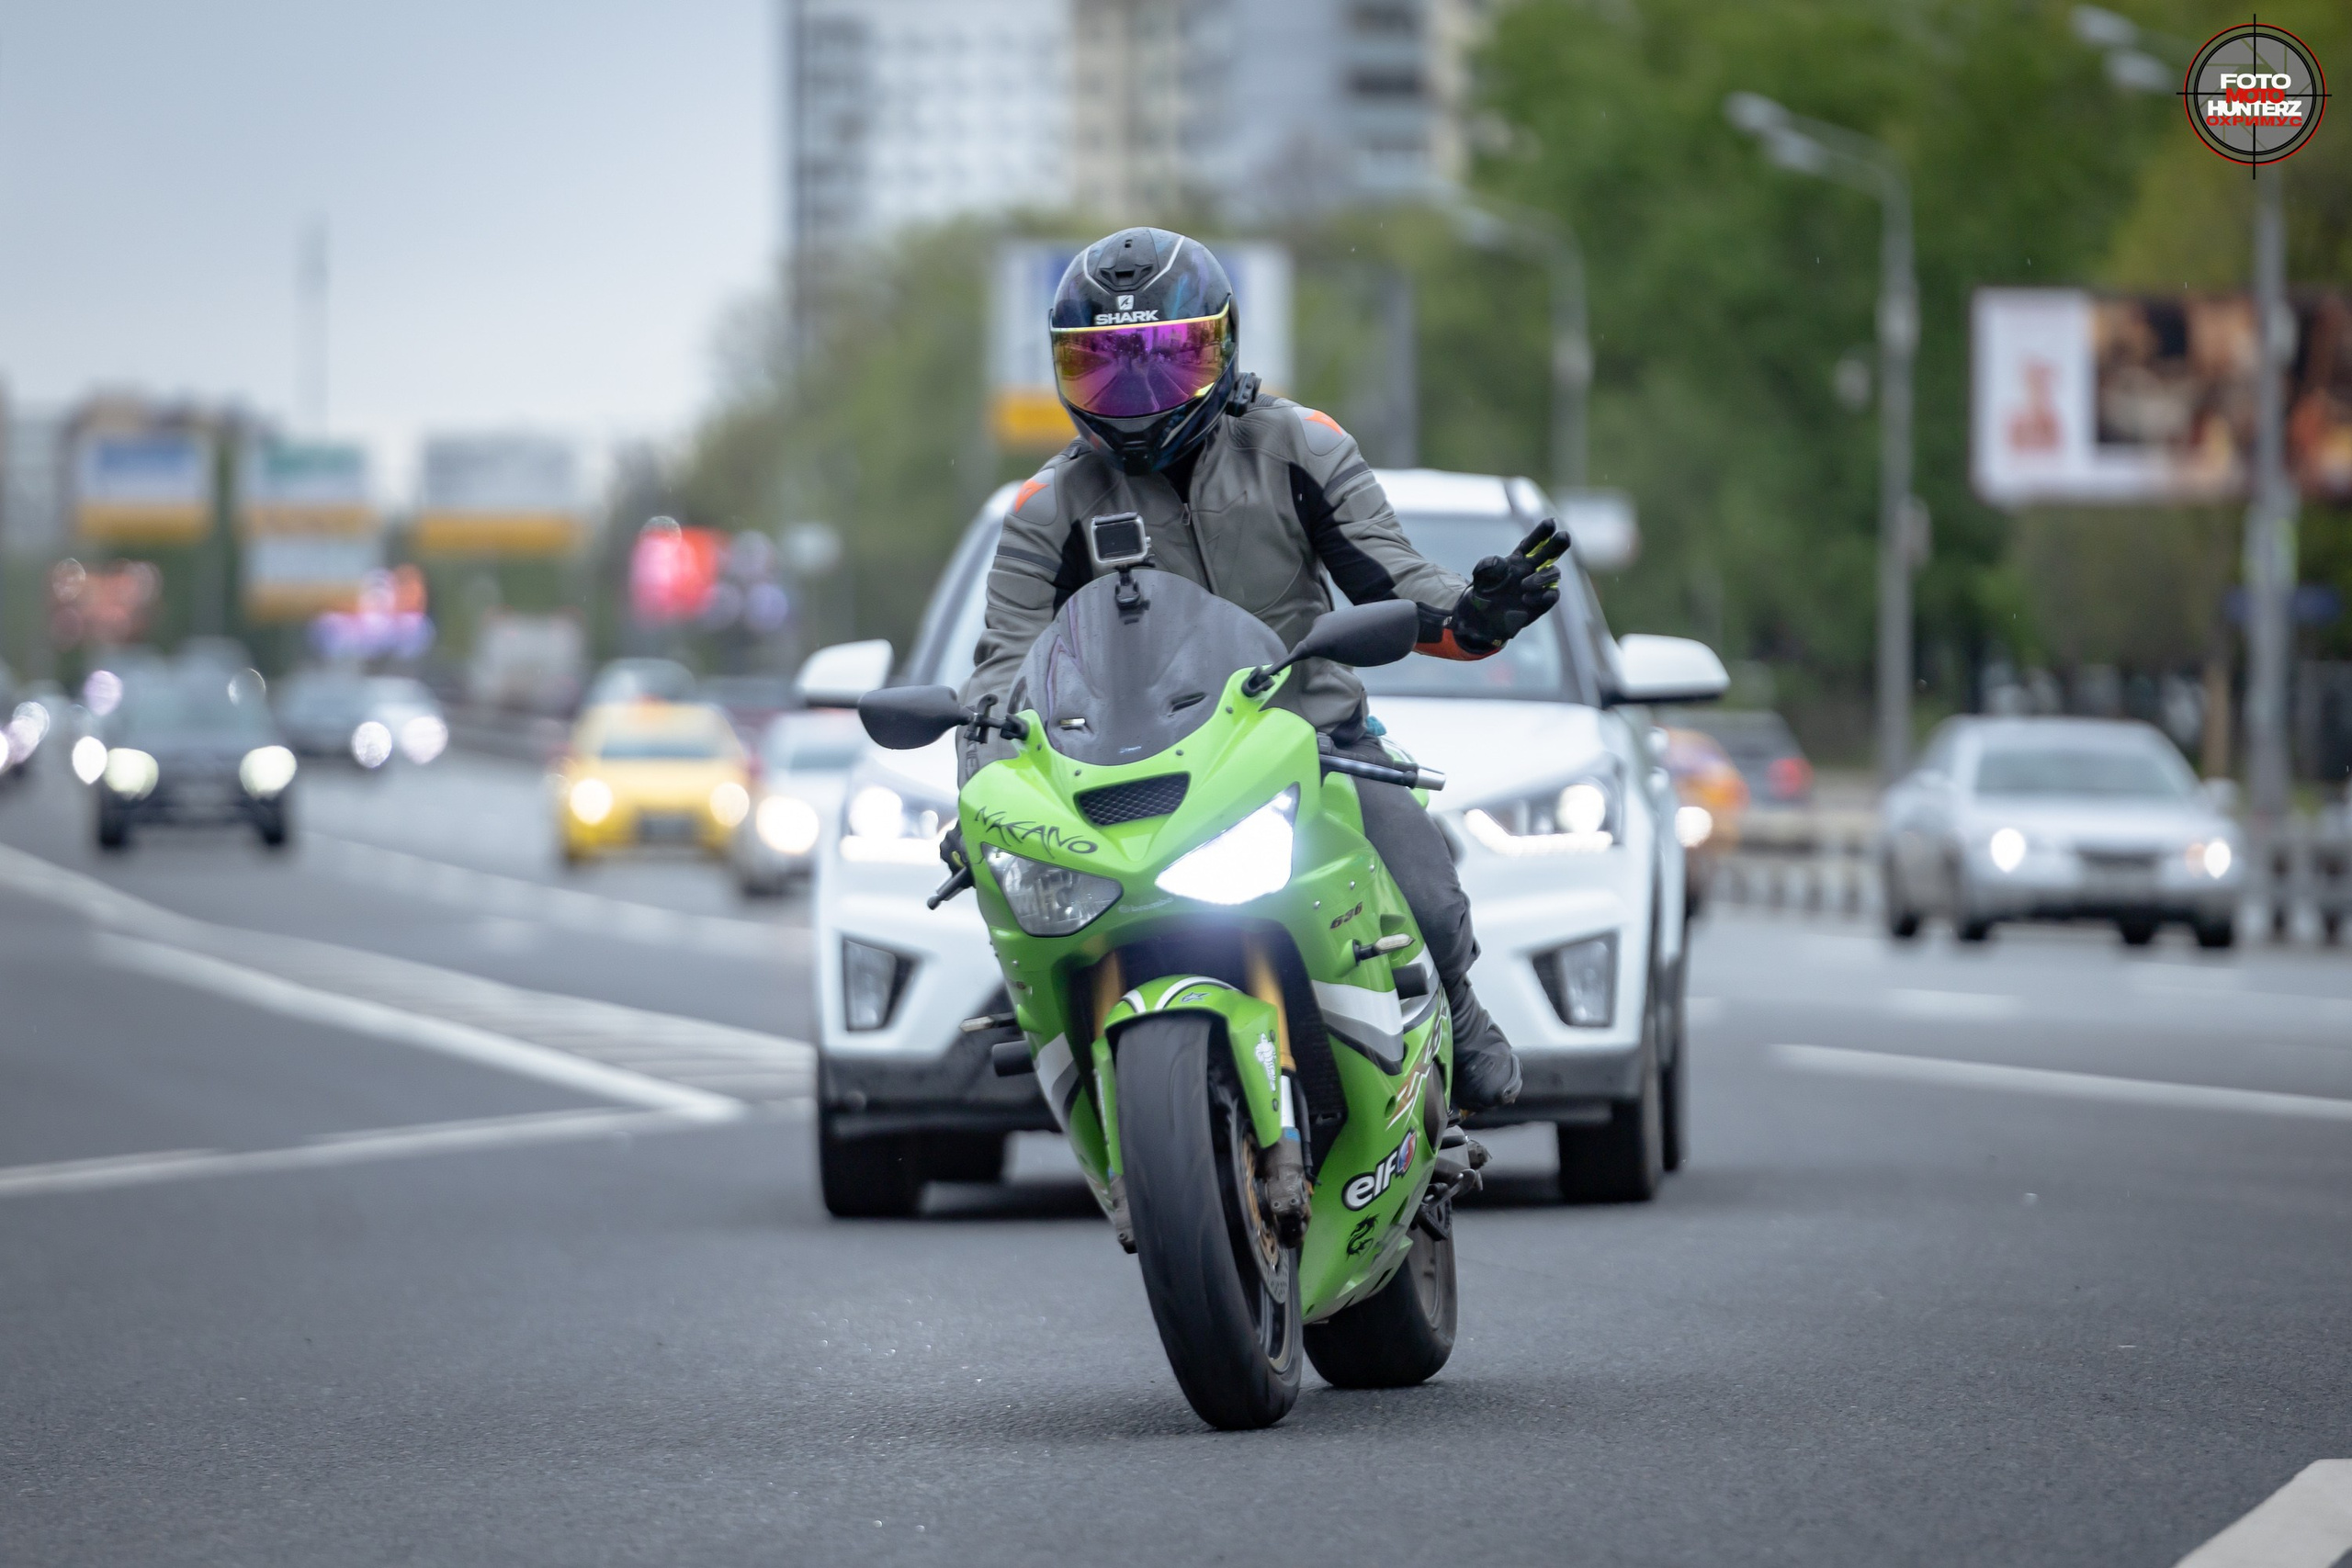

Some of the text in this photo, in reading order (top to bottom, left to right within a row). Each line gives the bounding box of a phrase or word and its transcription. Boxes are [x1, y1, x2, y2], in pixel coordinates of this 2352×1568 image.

[1095, 310, 1159, 325] SHARK
[1329, 901, 1363, 930] 636
[1344, 1156, 1398, 1210] elf
